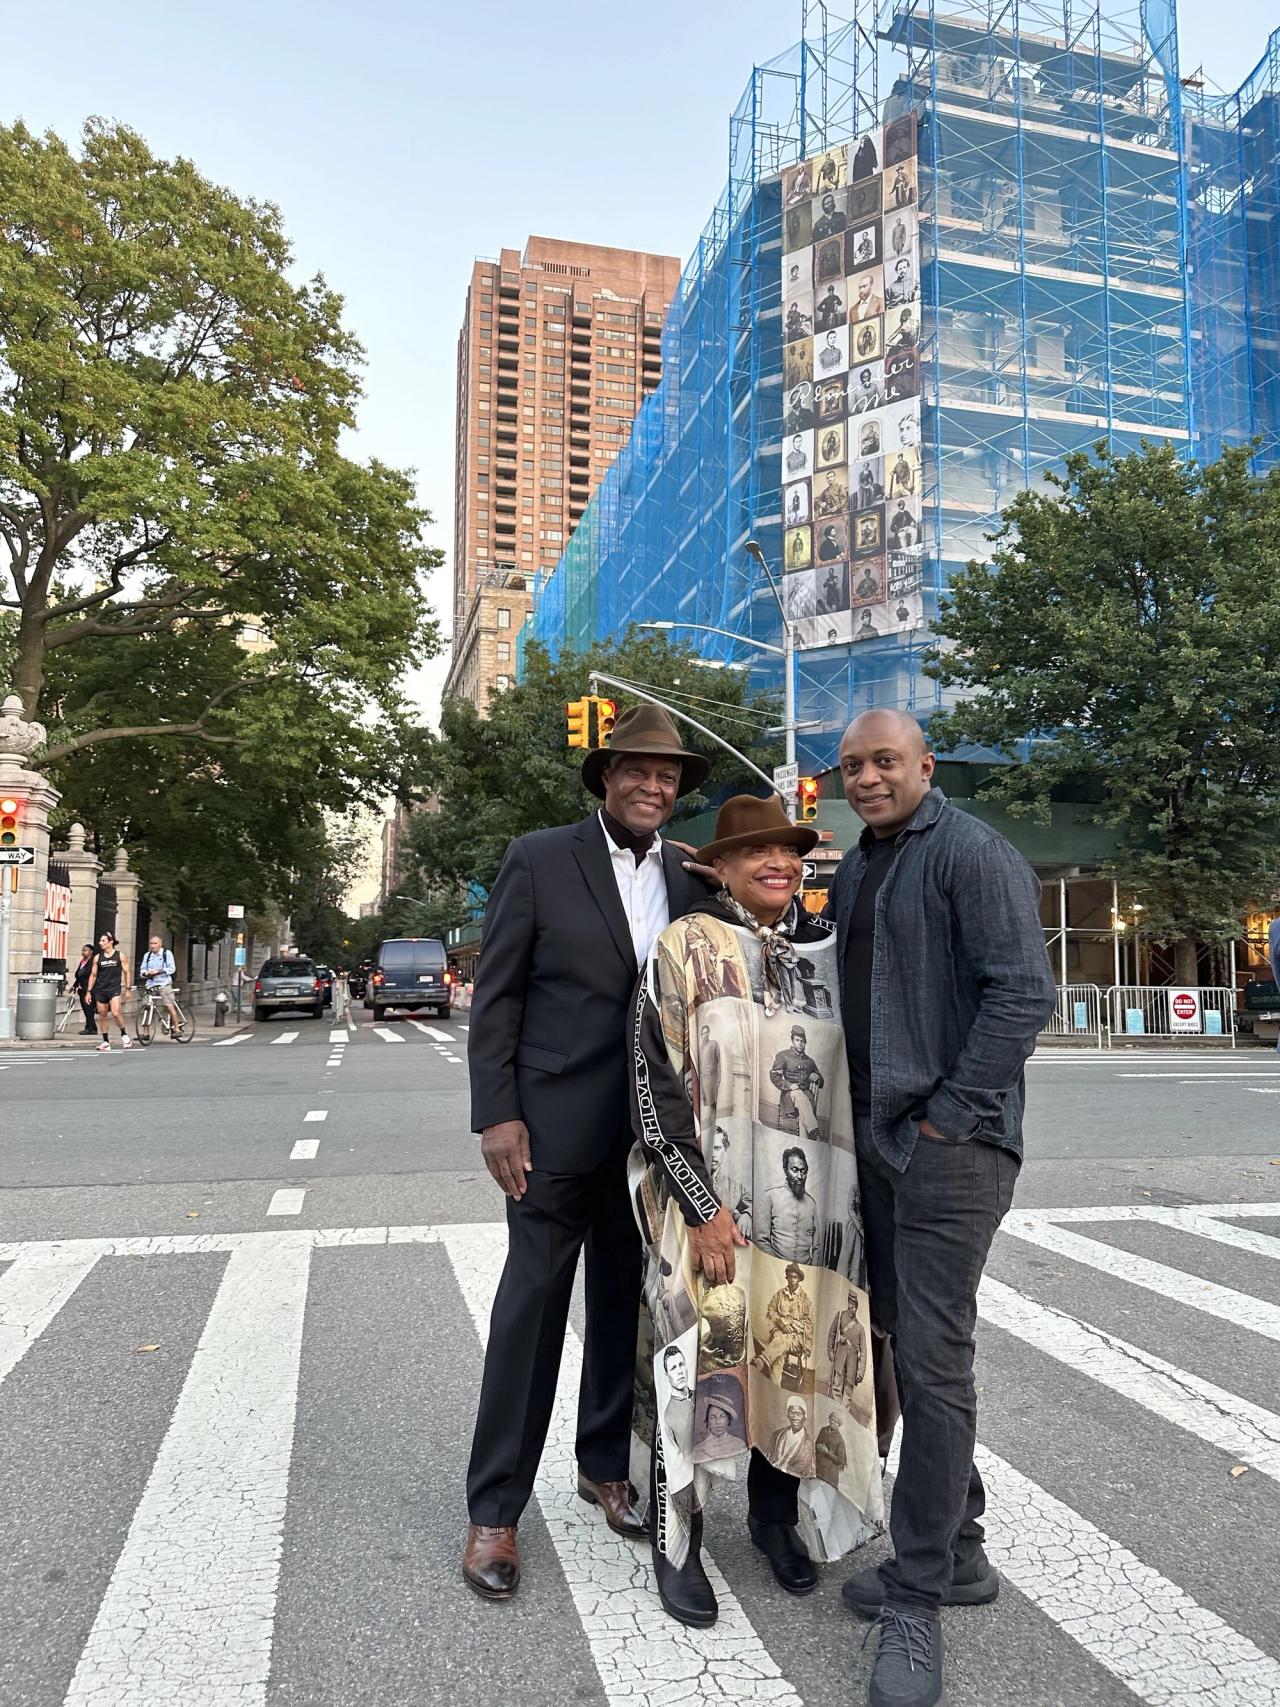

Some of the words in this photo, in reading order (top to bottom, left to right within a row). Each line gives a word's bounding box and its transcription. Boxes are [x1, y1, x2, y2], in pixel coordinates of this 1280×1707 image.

[775, 767, 796, 779] PASSENGER
[8, 852, 26, 860] WAY
[638, 1074, 666, 1150] WITHLOVE
